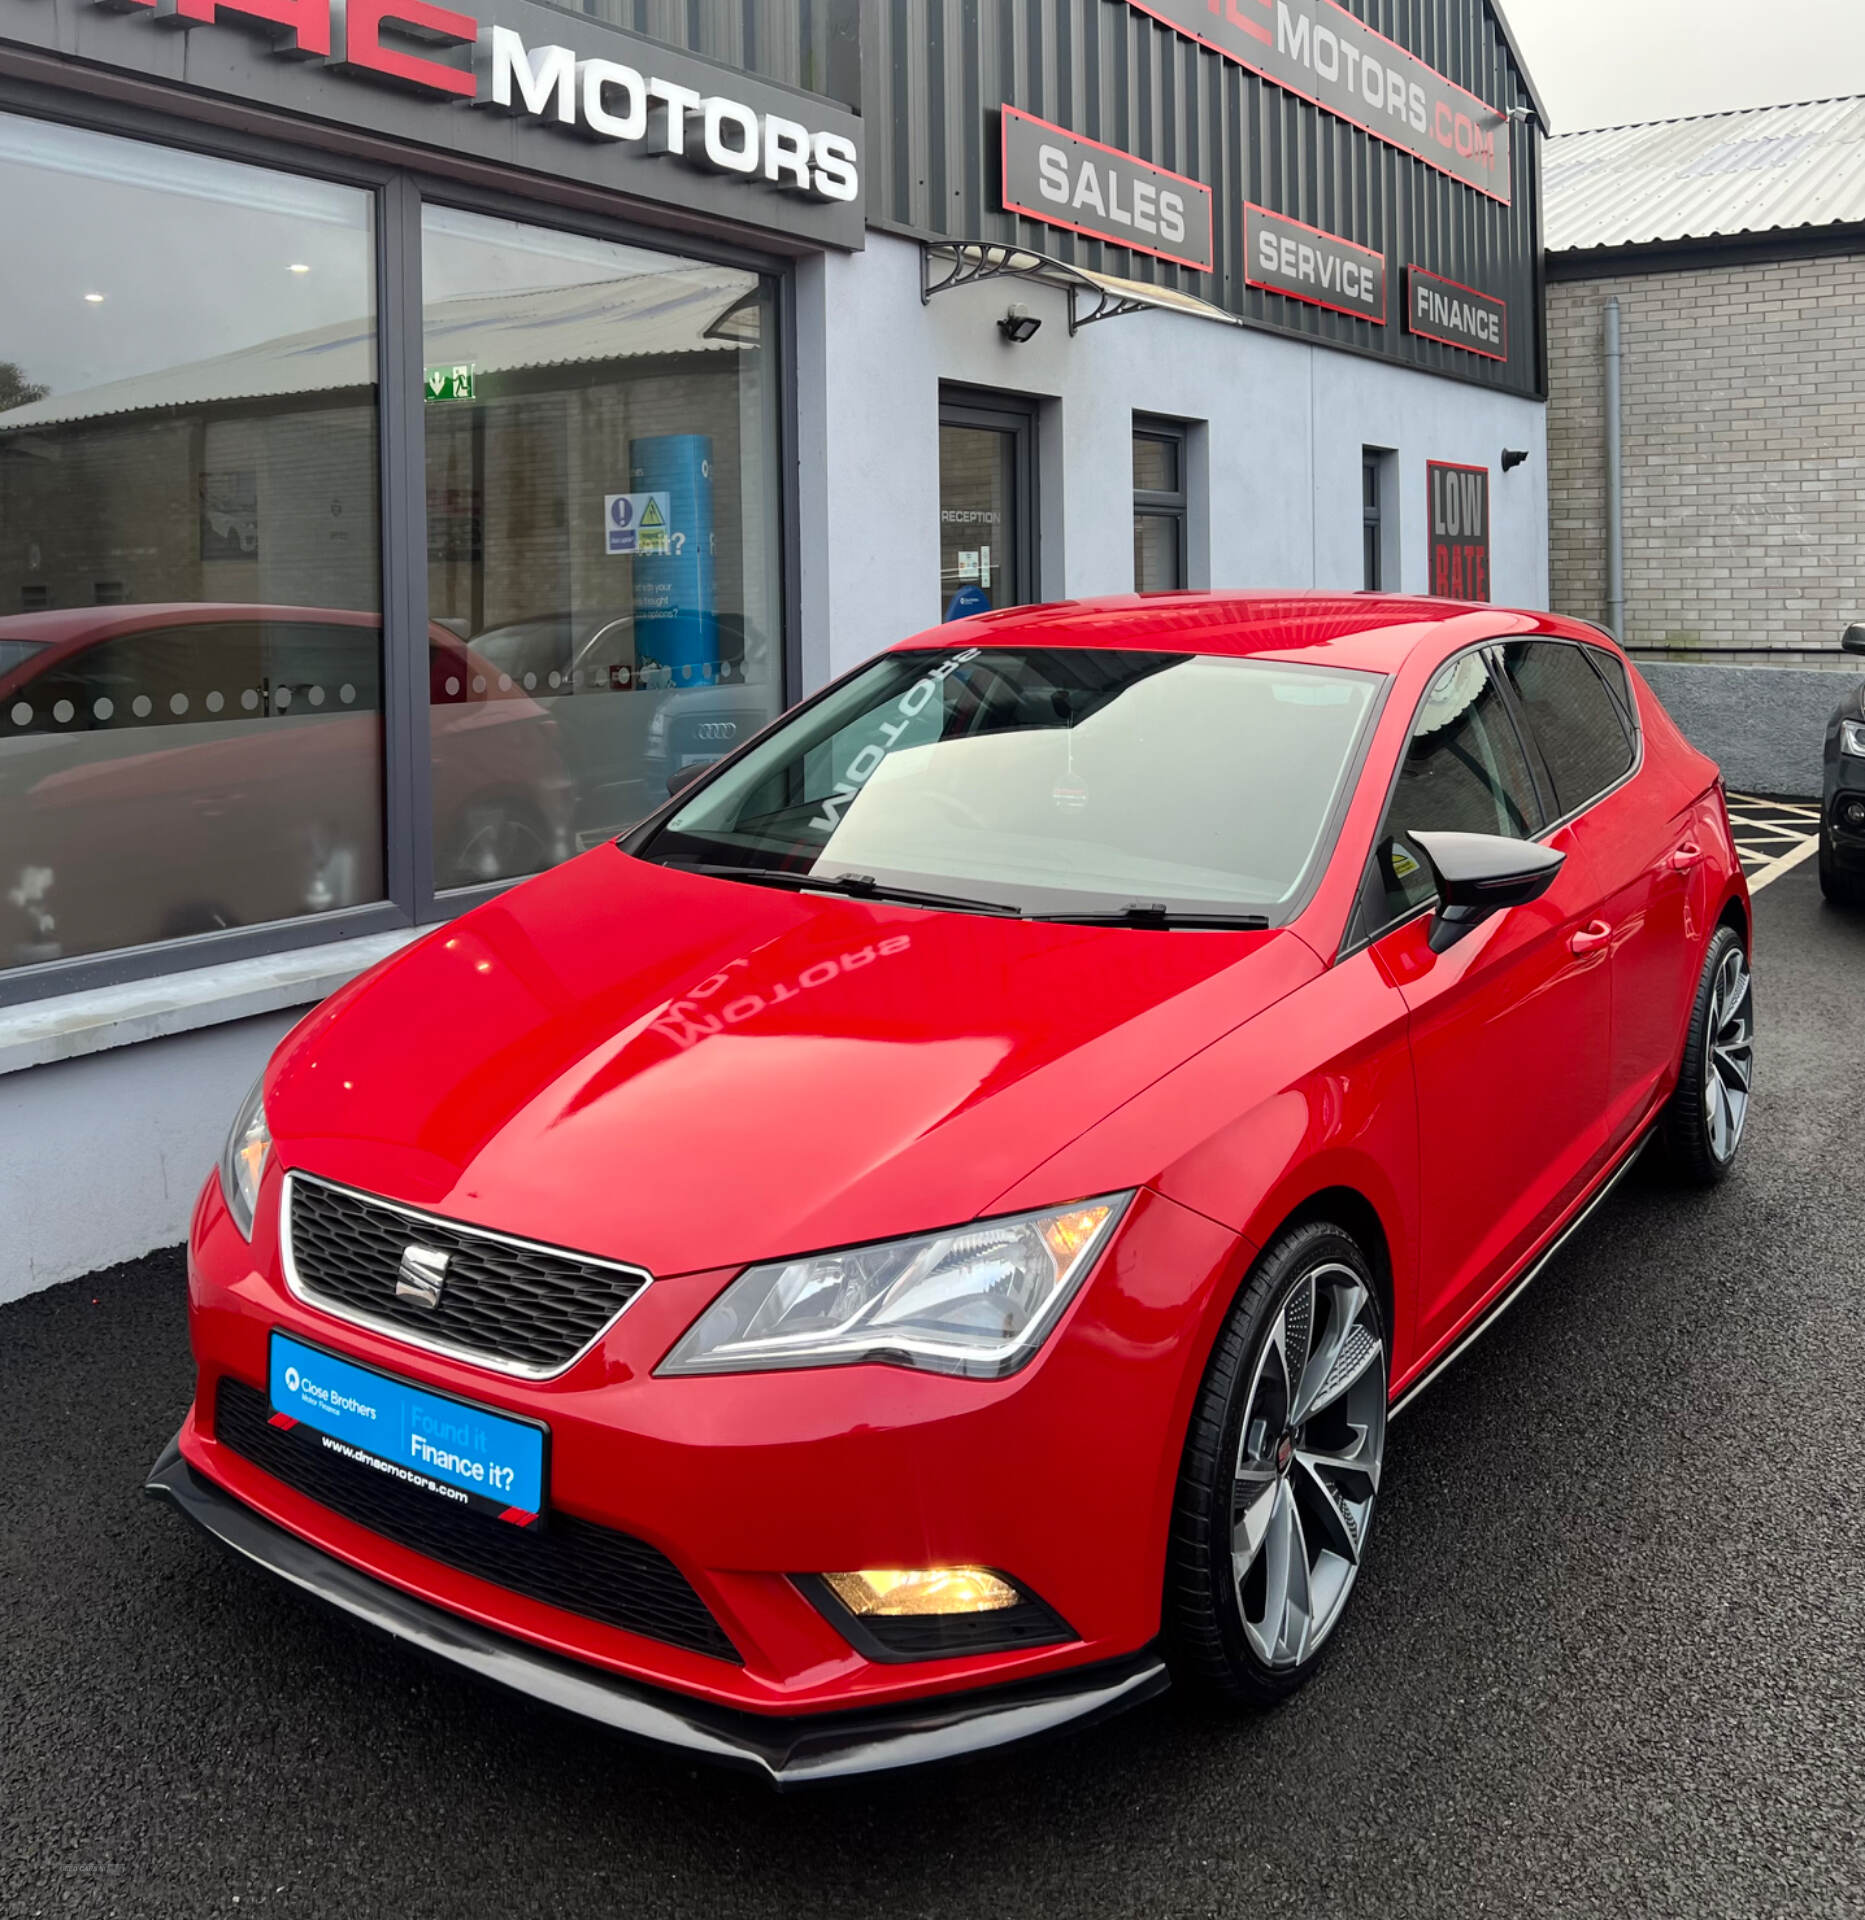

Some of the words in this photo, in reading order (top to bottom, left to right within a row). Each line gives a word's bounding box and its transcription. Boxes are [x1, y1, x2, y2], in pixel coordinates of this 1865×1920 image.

[491, 24, 858, 202] MOTORS
[1038, 144, 1186, 244] SALES
[1258, 229, 1374, 303] SERVICE
[1416, 286, 1499, 344] FINANCE
[941, 510, 1000, 523] RECEPTION
[1434, 469, 1482, 536] LOW
[1435, 544, 1485, 601] RATE
[301, 1378, 329, 1400] Close
[330, 1390, 377, 1420] Brothers
[411, 1405, 469, 1446] Found
[473, 1433, 487, 1454] it
[321, 1435, 469, 1505] www.dmacmotors.com
[411, 1433, 485, 1482] Finance
[489, 1461, 515, 1491] it?
